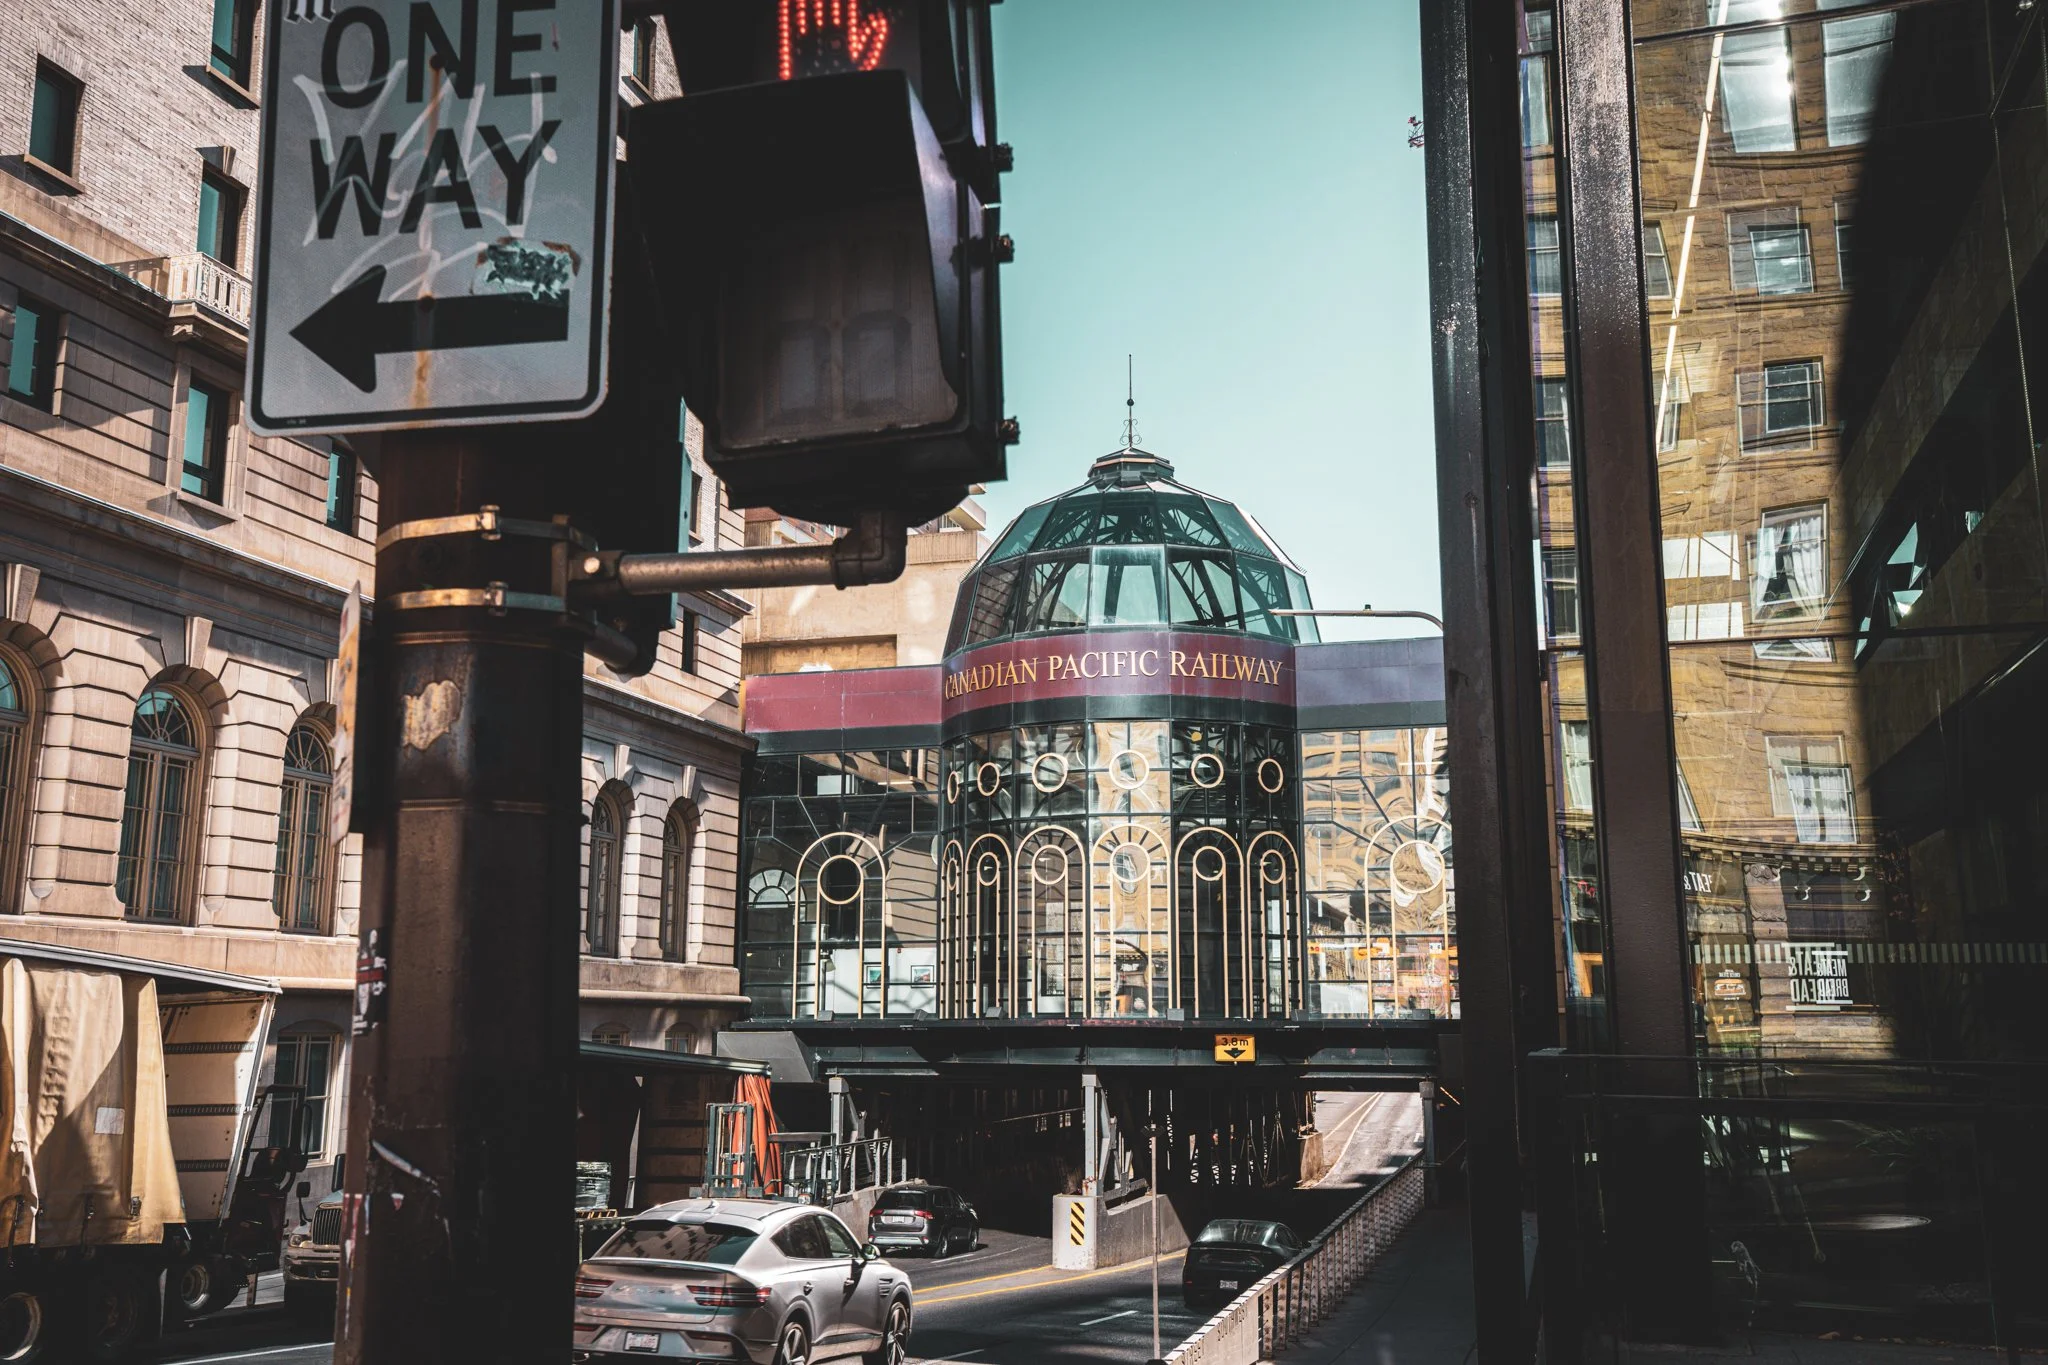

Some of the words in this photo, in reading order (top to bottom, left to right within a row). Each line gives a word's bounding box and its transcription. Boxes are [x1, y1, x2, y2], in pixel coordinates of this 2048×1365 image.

[320, 0, 559, 109] ONE
[309, 119, 562, 240] WAY
[945, 657, 1038, 700] CANADIAN
[1047, 649, 1160, 682] PACIFIC
[1169, 650, 1284, 686] RAILWAY
